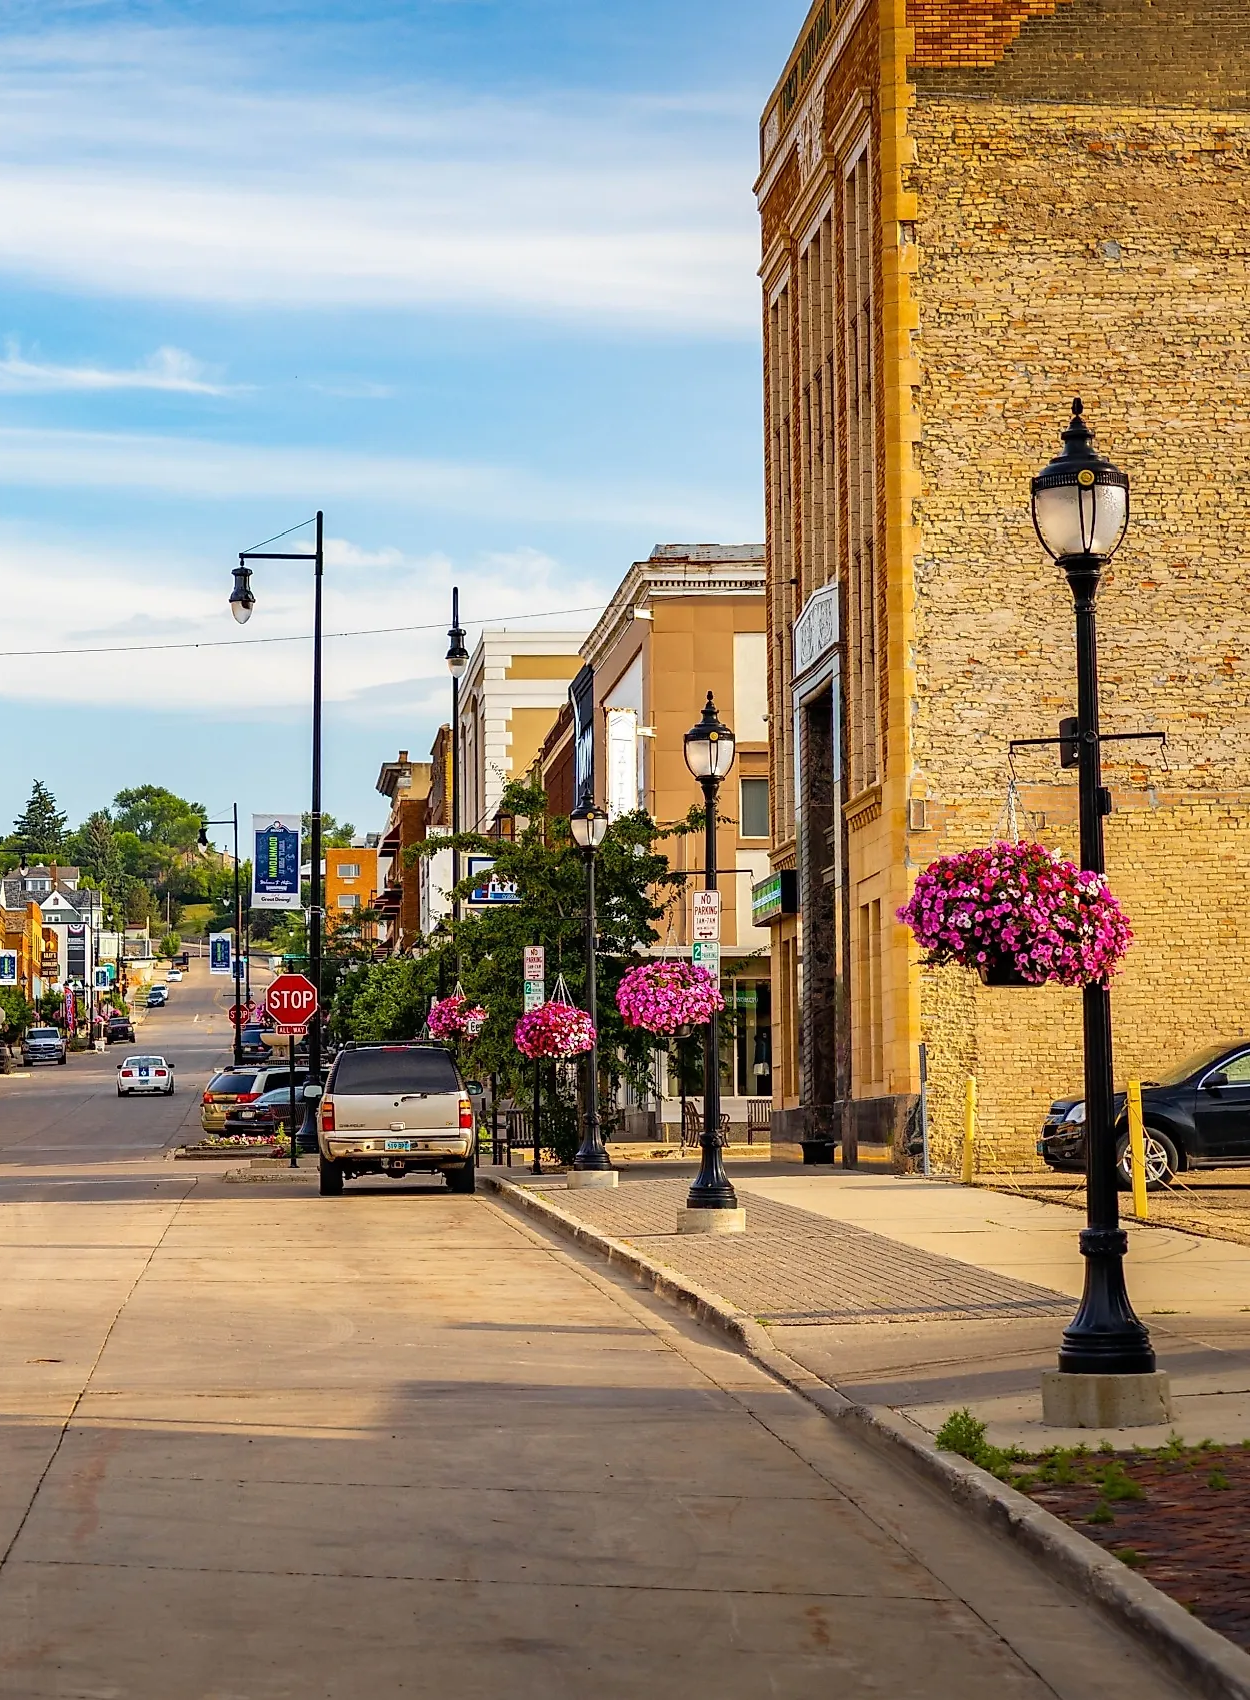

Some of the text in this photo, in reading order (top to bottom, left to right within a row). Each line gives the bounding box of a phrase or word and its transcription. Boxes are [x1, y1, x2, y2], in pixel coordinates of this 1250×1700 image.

[269, 836, 278, 878] DOWNTOWN
[701, 895, 712, 904] NO
[694, 906, 717, 915] PARKING
[694, 945, 701, 959] 2
[526, 983, 531, 993] 2
[269, 990, 314, 1009] STOP
